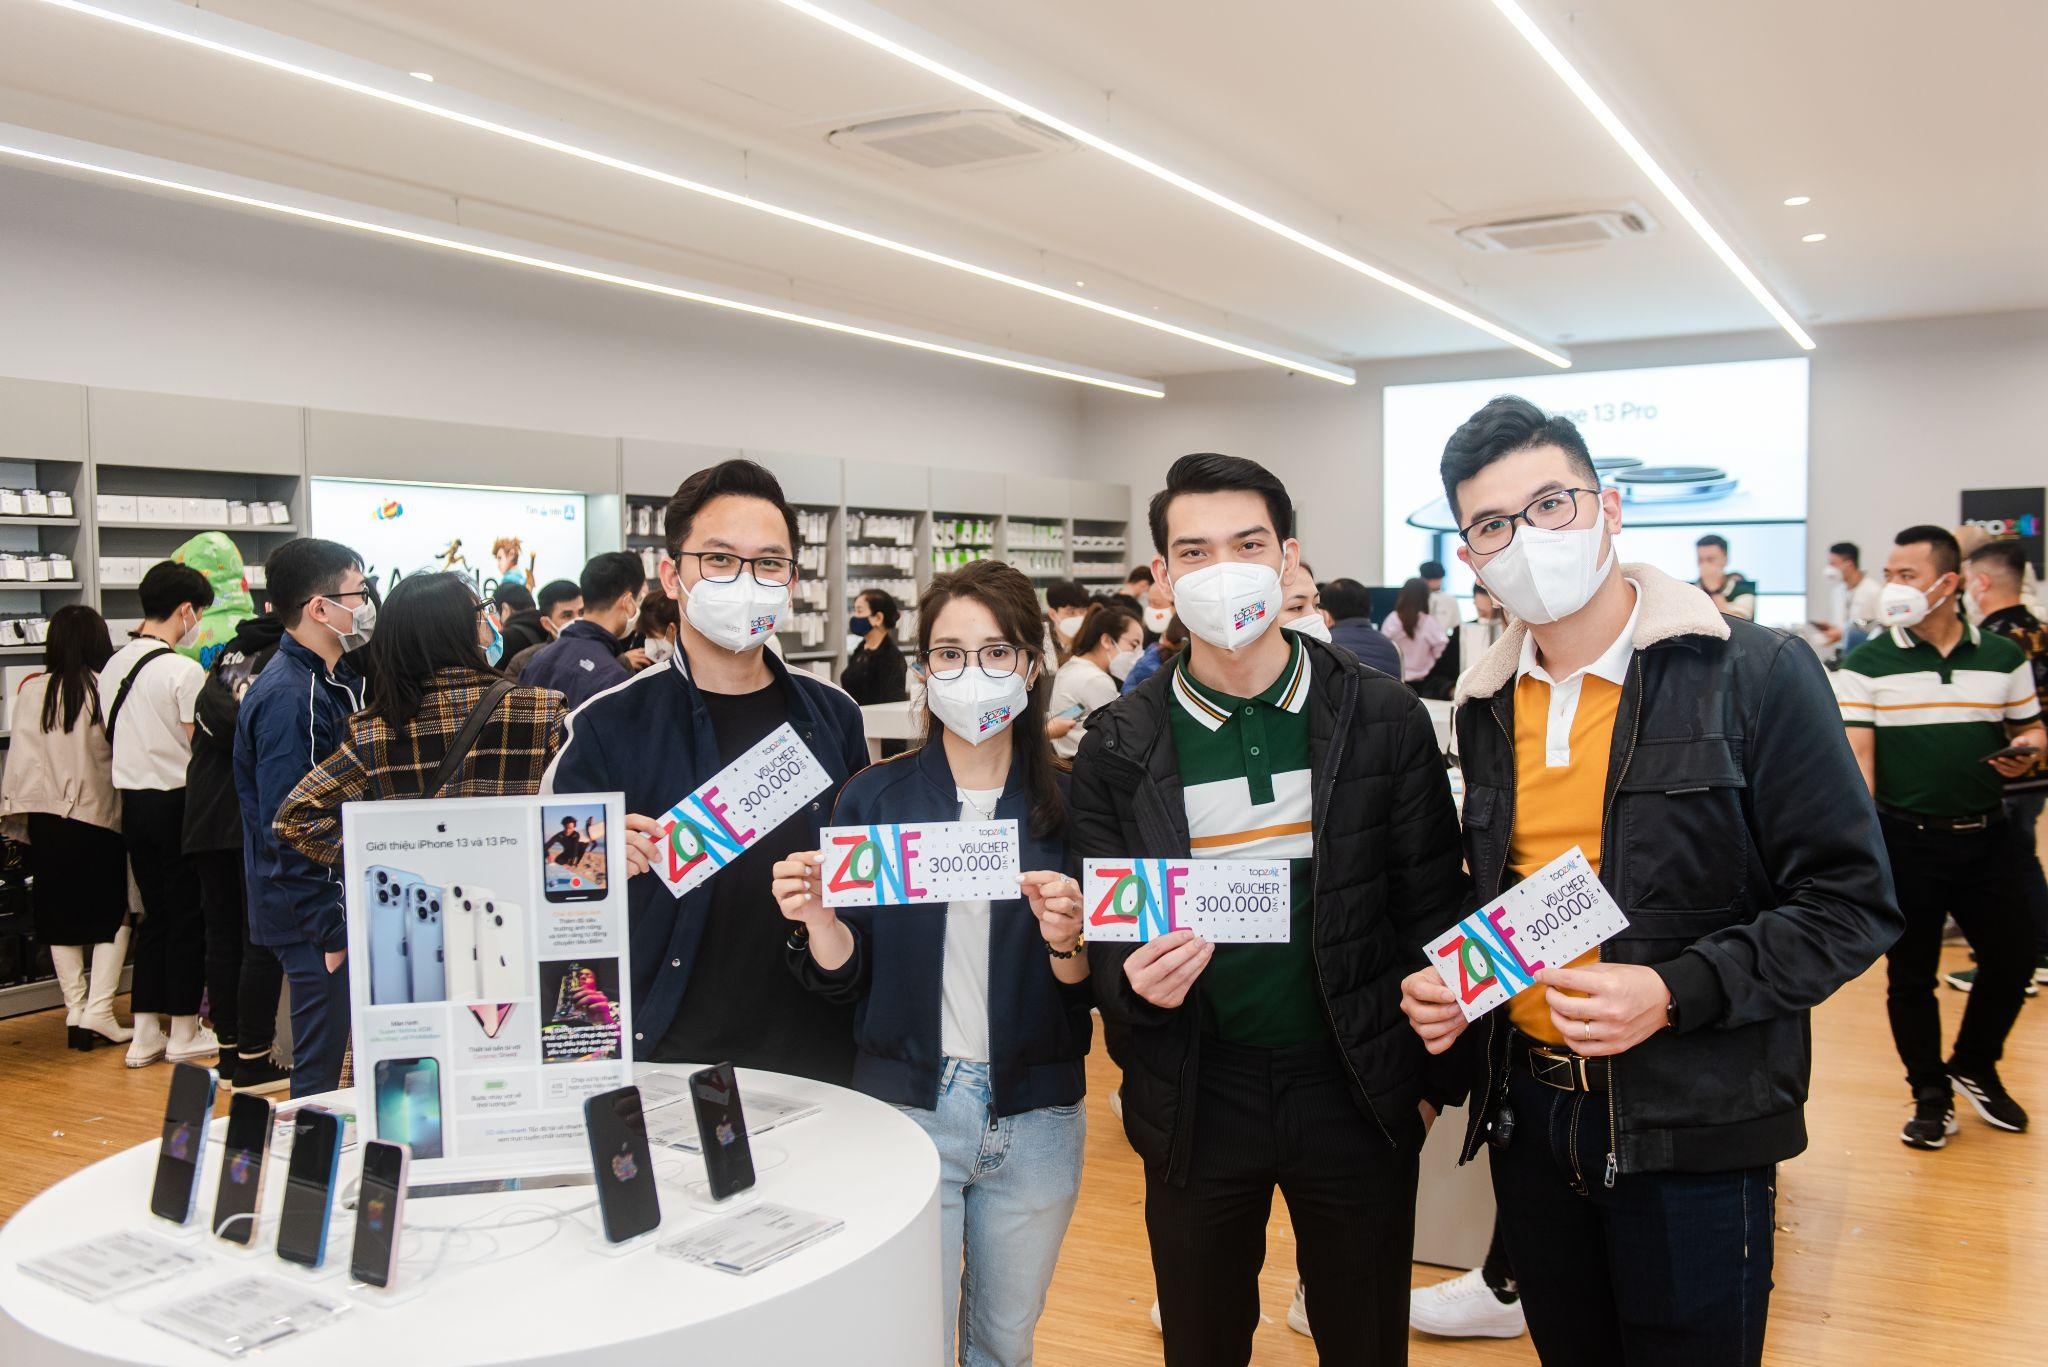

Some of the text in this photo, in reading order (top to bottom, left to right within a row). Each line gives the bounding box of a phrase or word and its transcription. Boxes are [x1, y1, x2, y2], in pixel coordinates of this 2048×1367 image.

[1594, 403, 1616, 422] 13
[1622, 401, 1658, 421] Pro
[754, 745, 799, 780] VOUCHER
[739, 761, 801, 813] 300.000
[417, 839, 454, 849] iPhone
[455, 838, 468, 847] 13
[485, 837, 498, 846] 13
[500, 836, 518, 845] Pro
[959, 841, 1009, 854] VOUCHER
[929, 854, 1002, 873] 300.000
[1227, 882, 1280, 895] VOUCHER
[1541, 874, 1589, 908] VOUCHER
[1196, 895, 1271, 913] 300.000
[1526, 892, 1592, 942] 300.000
